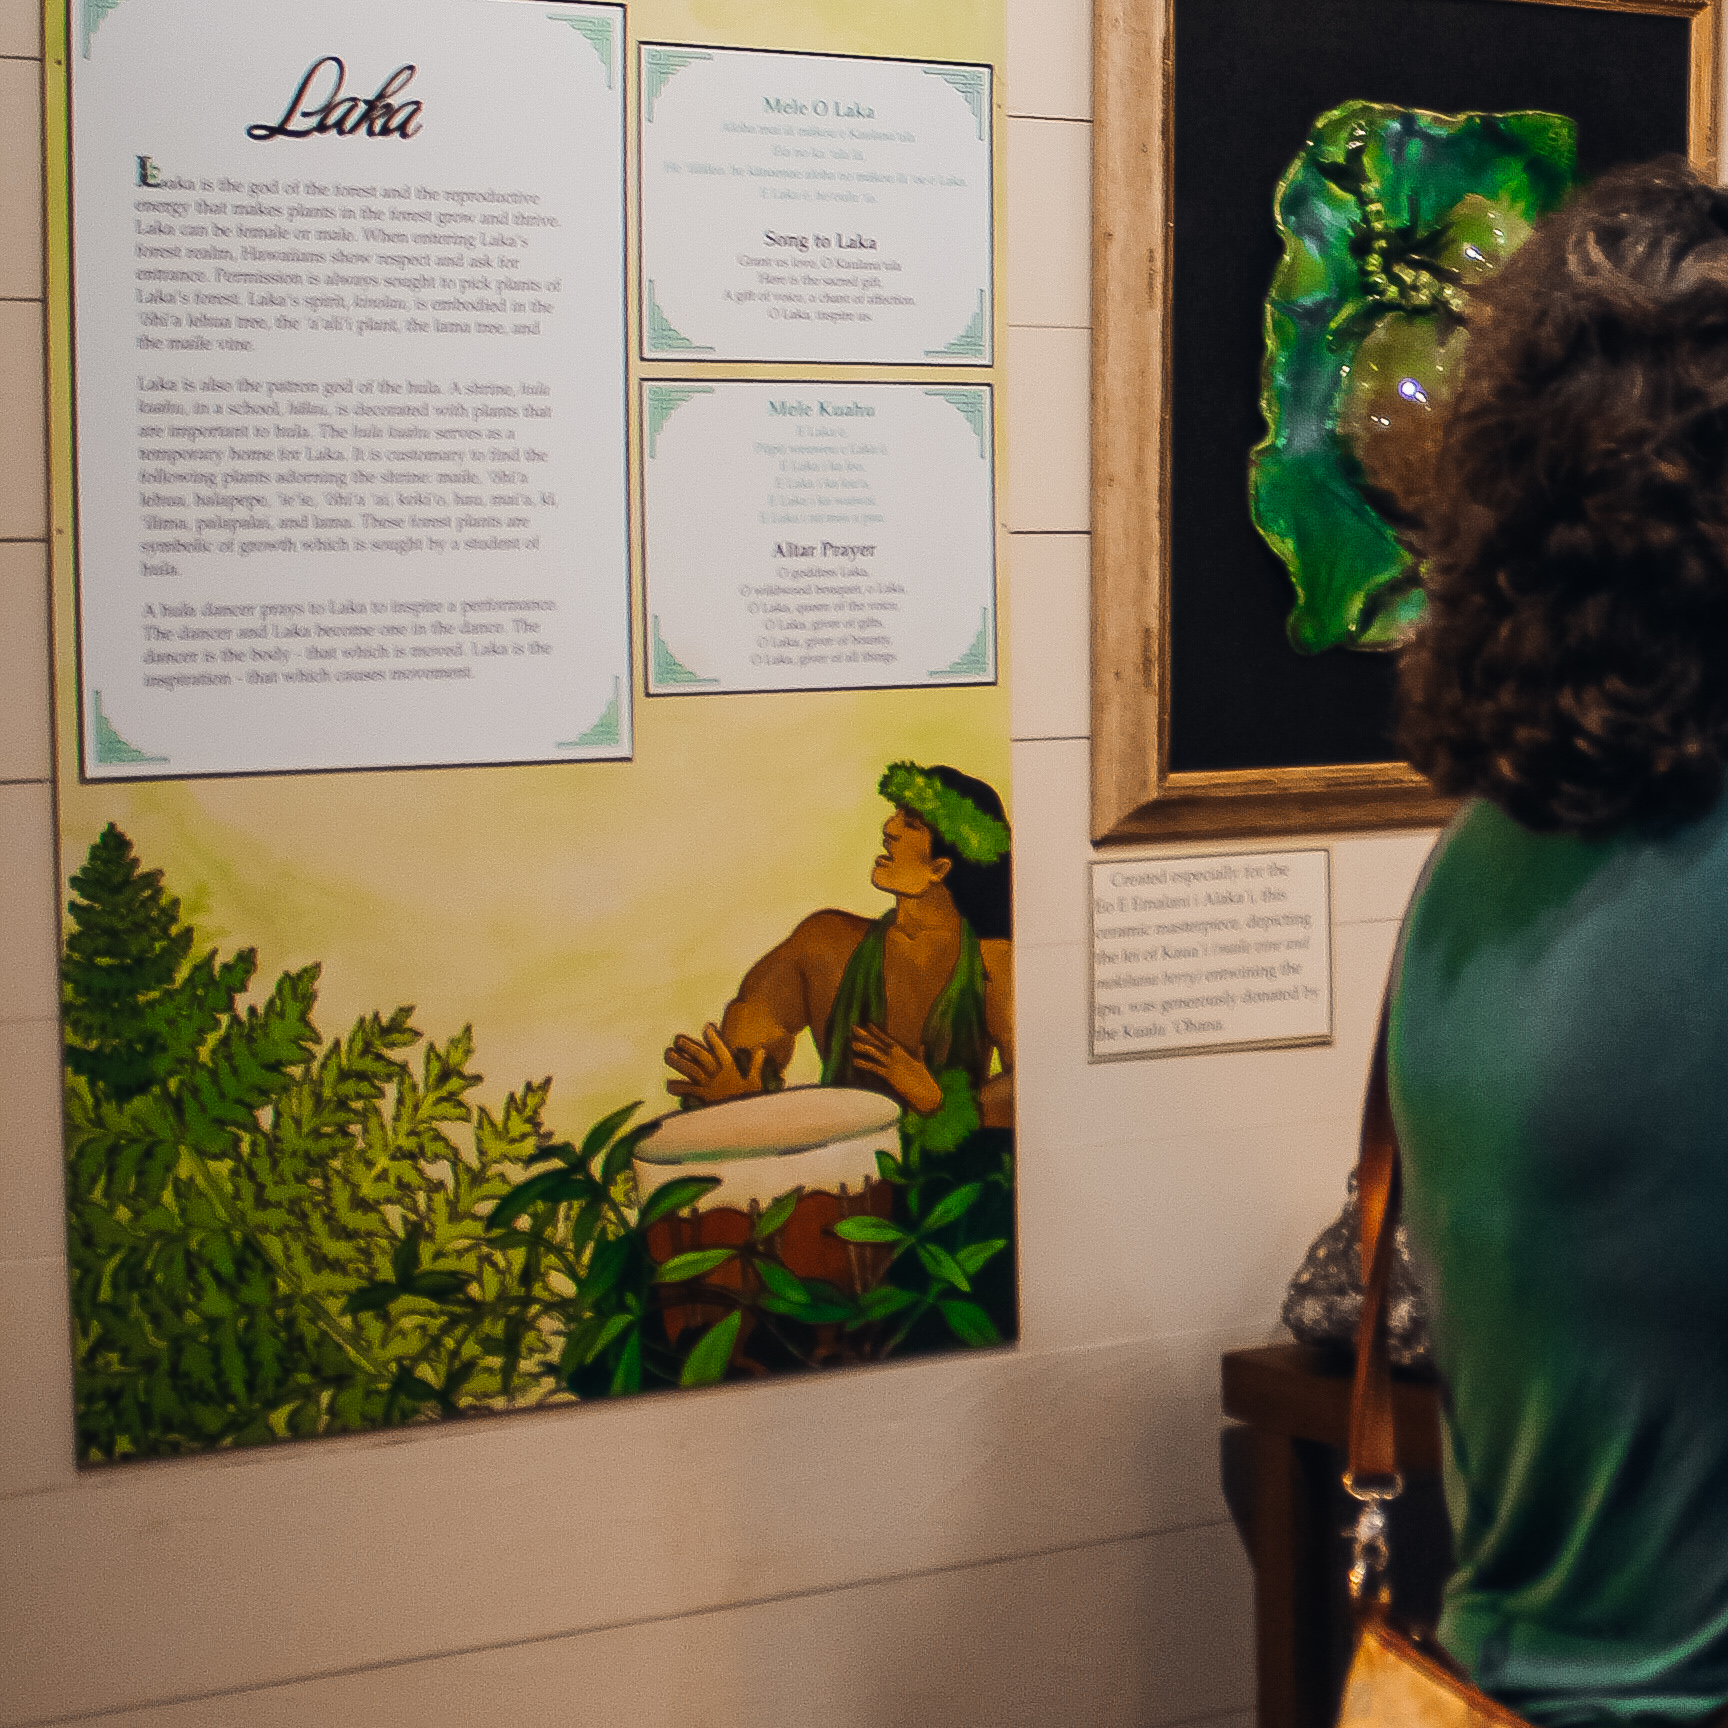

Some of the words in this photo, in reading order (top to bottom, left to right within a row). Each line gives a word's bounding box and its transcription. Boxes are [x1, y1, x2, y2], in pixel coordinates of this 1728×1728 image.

[246, 56, 424, 140] Laka
[763, 97, 807, 116] Mele
[813, 100, 829, 117] O
[835, 102, 875, 119] Laka
[202, 179, 215, 192] is
[219, 179, 242, 193] the
[249, 180, 279, 198] god
[283, 181, 301, 195] of
[305, 182, 329, 196] the
[334, 182, 376, 198] forest
[382, 185, 410, 199] and
[416, 186, 439, 200] the
[444, 188, 539, 206] reproductive
[134, 203, 190, 219] energy
[195, 201, 226, 216] that
[232, 202, 282, 217] makes
[287, 204, 335, 222] plants
[341, 207, 355, 220] in
[360, 206, 384, 221] the
[390, 207, 431, 223] forest
[437, 213, 475, 228] grow
[481, 211, 508, 225] and
[135, 221, 174, 236] Laka
[180, 227, 207, 237] can
[213, 223, 232, 238] be
[236, 224, 289, 240] female
[294, 230, 310, 240] or
[362, 228, 407, 243] When
[413, 232, 476, 250] entering
[764, 230, 808, 252] Song
[814, 233, 831, 250] to
[836, 233, 877, 250] Laka
[135, 244, 181, 259] forest
[242, 247, 324, 263] Hawaiians
[331, 250, 373, 265] show
[378, 254, 431, 270] respect
[436, 253, 464, 267] and
[469, 254, 492, 268] ask
[497, 254, 519, 269] for
[214, 269, 302, 285] Permission
[308, 273, 320, 286] is
[325, 272, 378, 291] always
[384, 274, 435, 293] sought
[441, 276, 456, 289] to
[460, 276, 492, 294] pick
[497, 276, 540, 295] plants
[545, 278, 561, 292] of
[769, 401, 812, 416] Mele
[818, 402, 876, 417] Kuahu
[773, 542, 816, 558] Altar
[822, 542, 876, 560] Prayer
[143, 604, 156, 618] A
[160, 603, 196, 618] hula
[202, 603, 255, 617] dancer
[260, 605, 304, 620] prays
[309, 603, 325, 615] to
[329, 600, 366, 615] Laka
[371, 601, 387, 614] to
[391, 601, 442, 618] inspire
[448, 603, 456, 613] a
[143, 626, 173, 641] The
[179, 626, 232, 640] dancer
[237, 625, 268, 639] and
[272, 624, 310, 639] Laka
[315, 624, 374, 638] become
[379, 627, 406, 637] one
[412, 624, 426, 636] in
[431, 622, 455, 636] the
[512, 620, 539, 635] The
